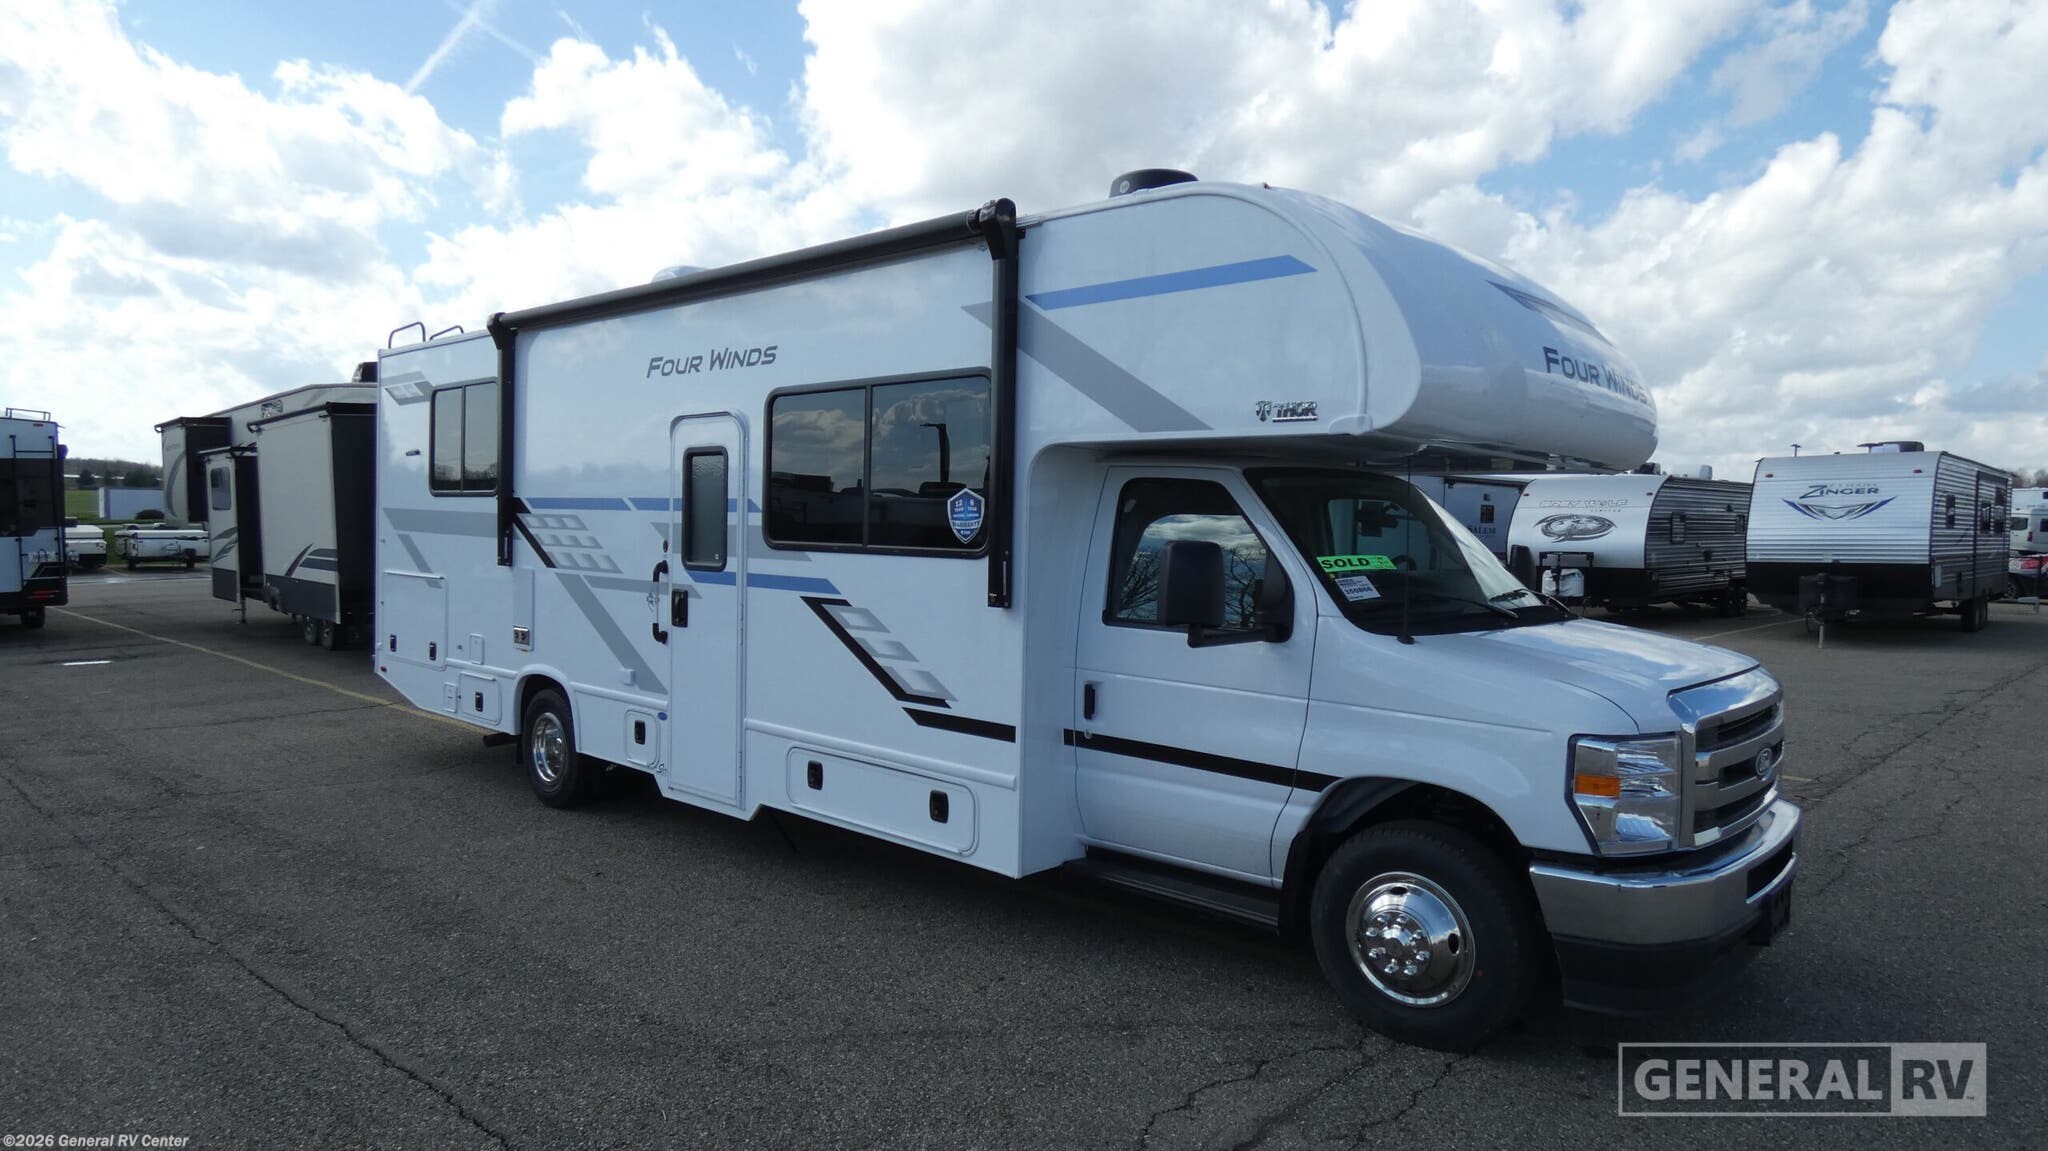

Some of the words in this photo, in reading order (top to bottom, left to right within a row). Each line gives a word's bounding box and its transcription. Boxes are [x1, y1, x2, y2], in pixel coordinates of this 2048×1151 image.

[646, 355, 703, 379] FOUR
[709, 345, 778, 371] WINDS
[1542, 346, 1600, 385] FOUR
[1600, 360, 1648, 404] WINDS
[1272, 401, 1318, 417] THOR
[1798, 485, 1880, 500] ZINGER
[1467, 525, 1497, 534] SALEM
[1321, 557, 1370, 569] SOLD
